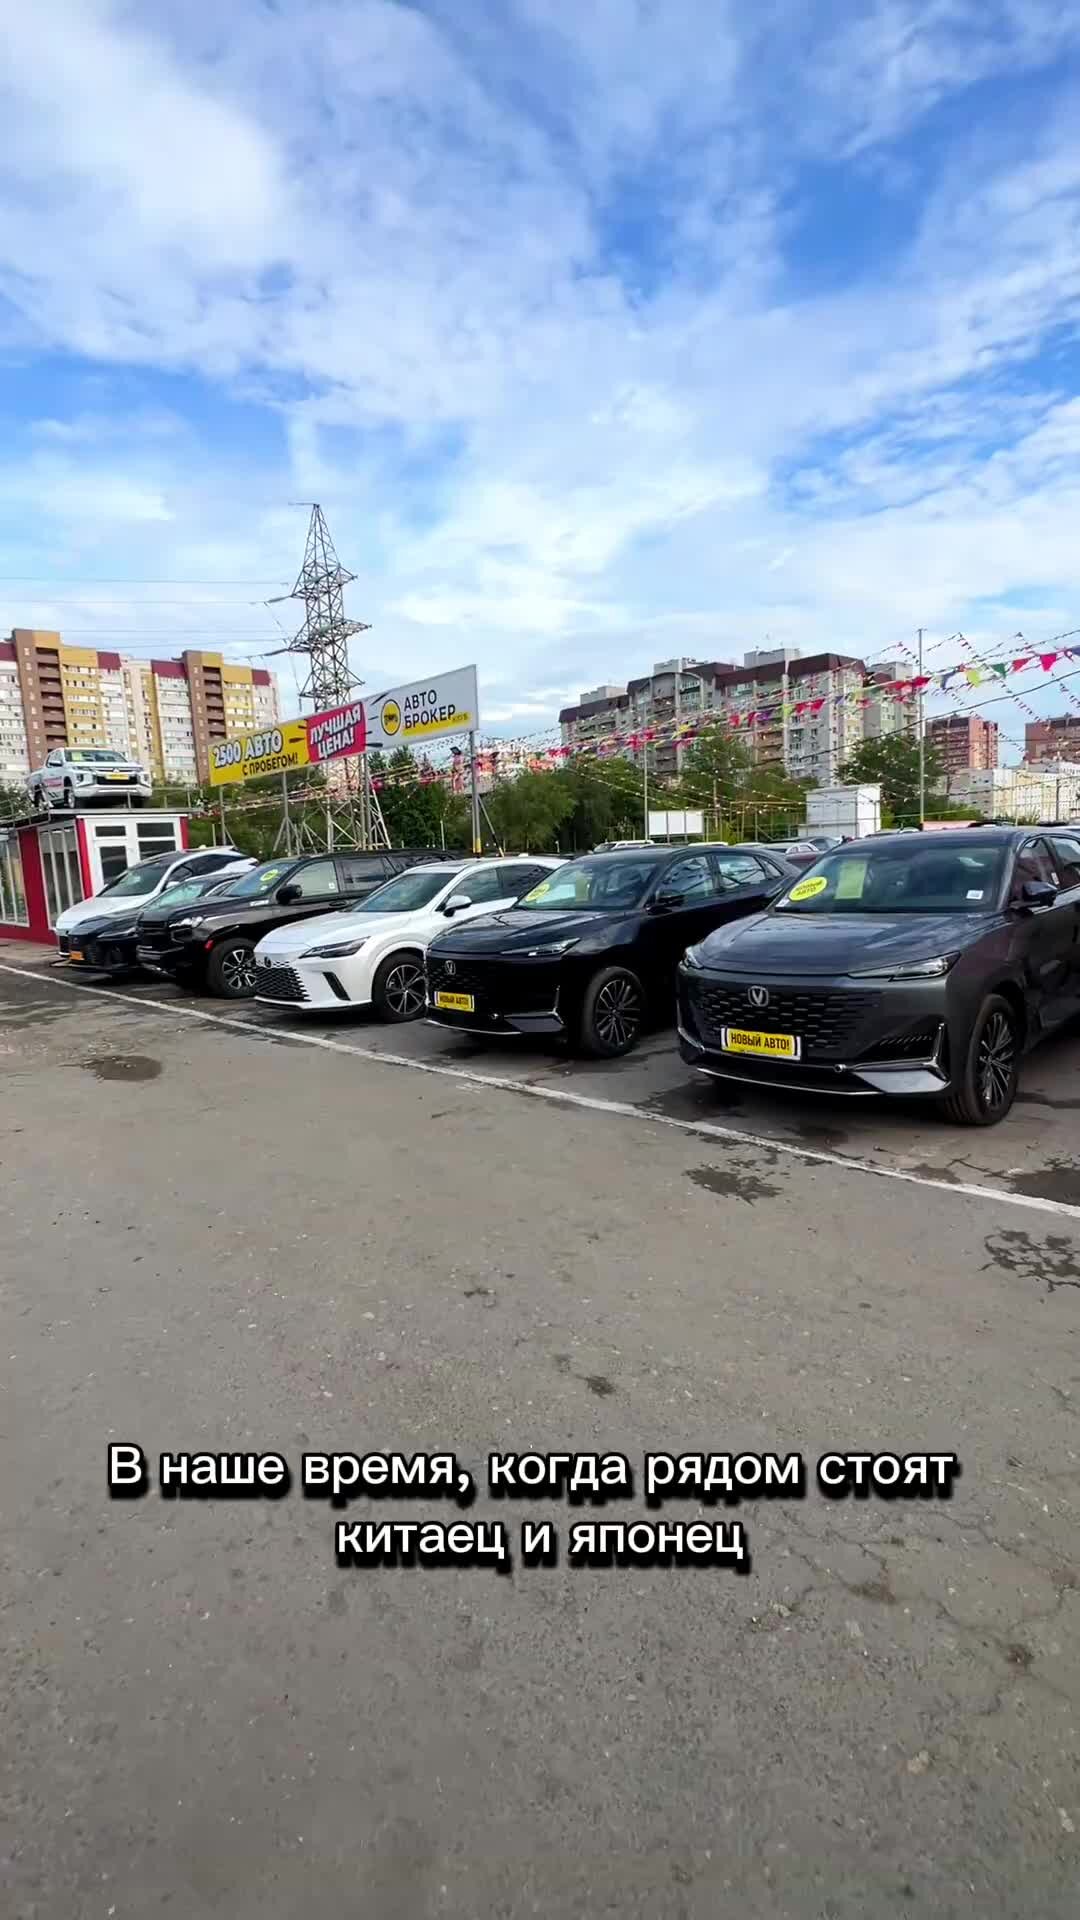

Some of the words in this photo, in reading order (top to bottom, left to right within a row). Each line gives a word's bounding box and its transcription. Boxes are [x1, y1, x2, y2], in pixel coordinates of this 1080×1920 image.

[404, 690, 437, 712] АВТО
[310, 704, 362, 745] ЛУЧШАЯ
[404, 704, 456, 729] БРОКЕР
[214, 739, 243, 768] 2500
[245, 729, 283, 761] АВТО
[317, 727, 355, 759] ЦЕНА!
[249, 752, 298, 775] ПРОБЕГОМ!
[731, 1032, 761, 1047] НОВЫЙ
[764, 1037, 790, 1051] АВТО!
